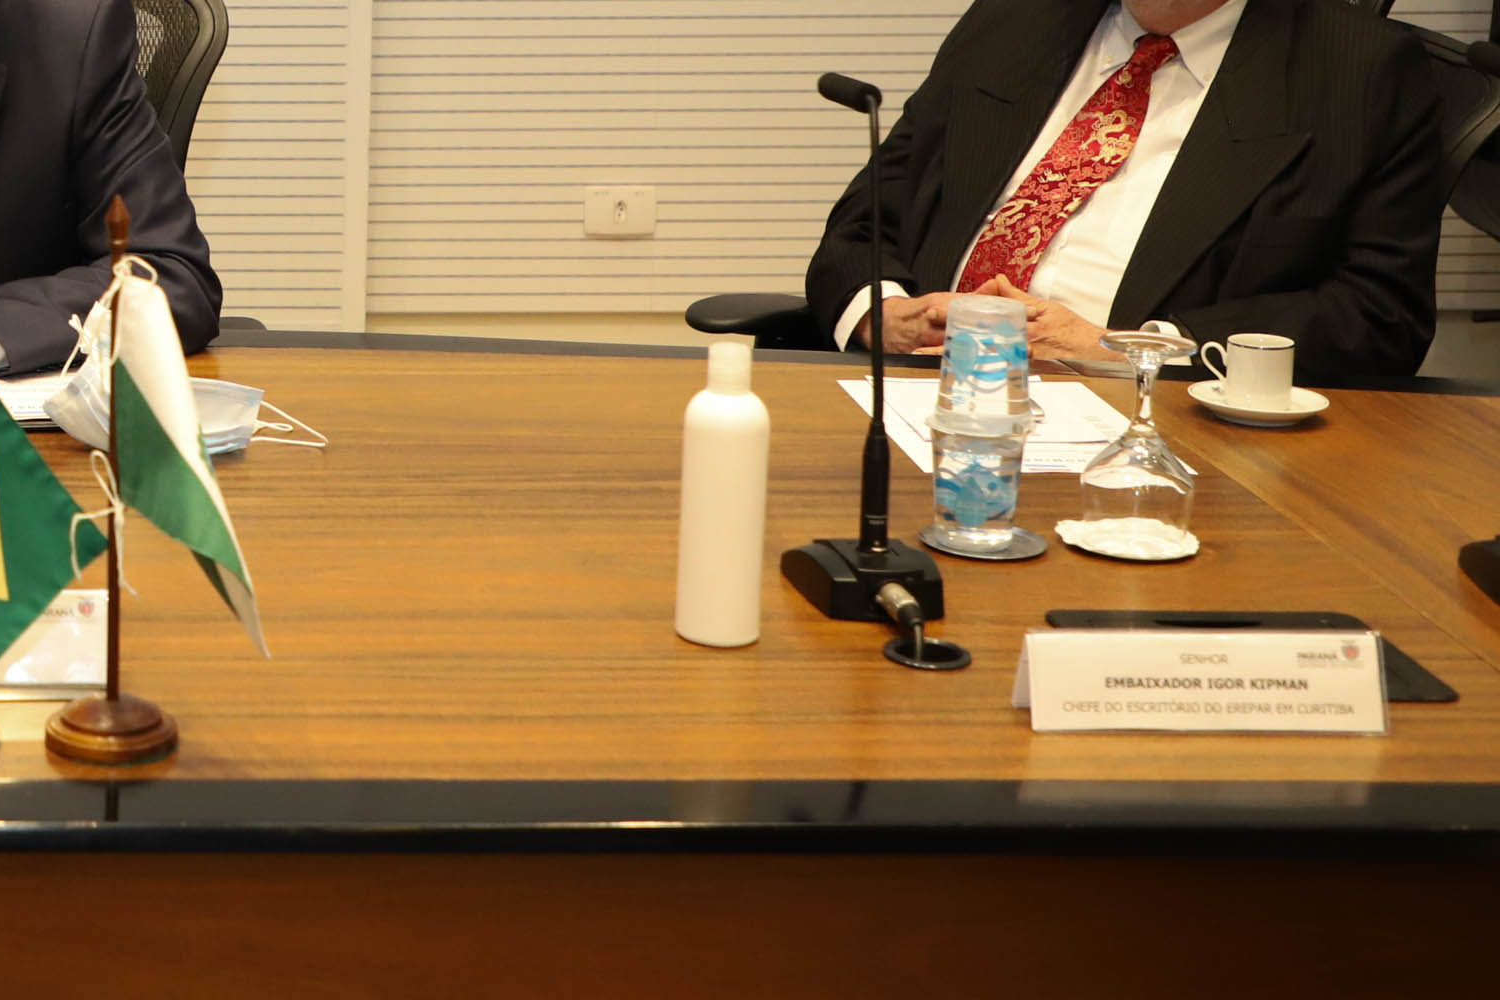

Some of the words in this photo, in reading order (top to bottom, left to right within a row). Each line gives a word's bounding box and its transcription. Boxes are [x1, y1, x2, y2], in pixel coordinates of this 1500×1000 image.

[1180, 654, 1228, 664] SENHOR
[1105, 677, 1202, 689] EMBAIXADOR
[1208, 678, 1244, 689] IGOR
[1250, 678, 1308, 690] KIPMAN
[1063, 701, 1100, 712] CHEFE
[1105, 702, 1123, 712] DO
[1204, 703, 1222, 713] DO
[1276, 703, 1293, 714] EM
